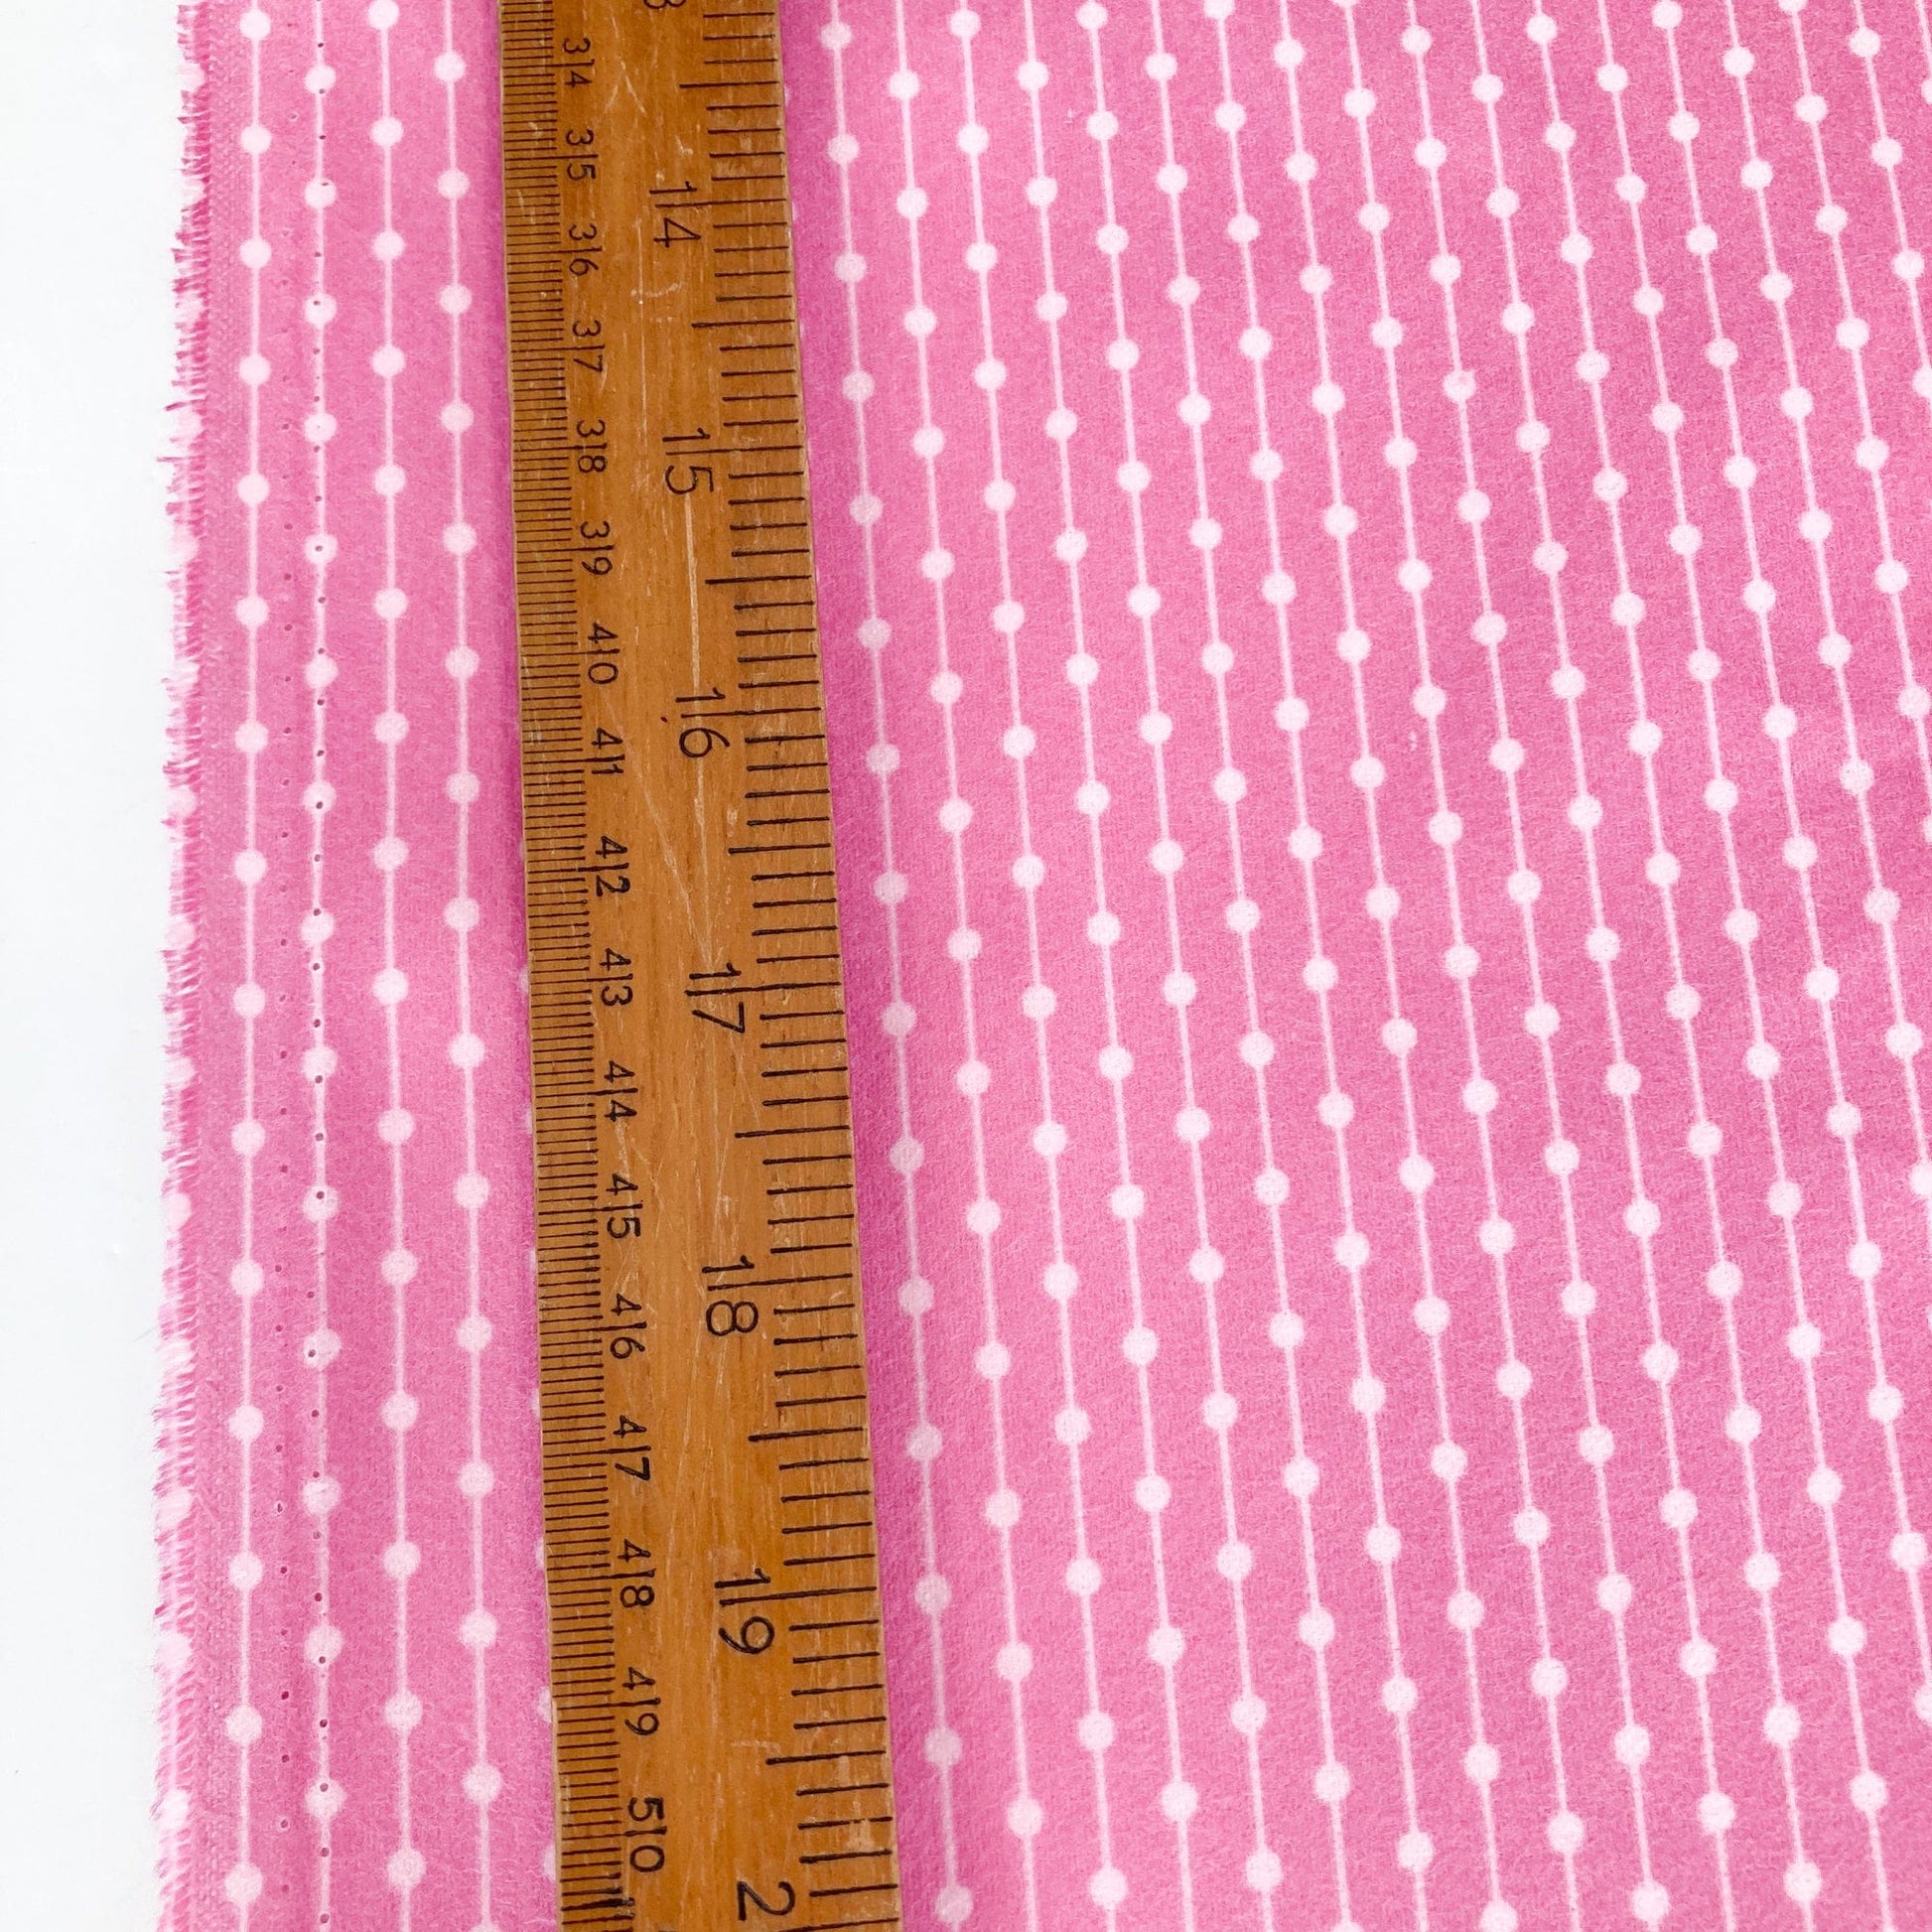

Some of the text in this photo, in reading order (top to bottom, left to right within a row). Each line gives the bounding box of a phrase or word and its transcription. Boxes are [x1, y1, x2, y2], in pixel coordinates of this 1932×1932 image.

[563, 37, 594, 88] 34
[566, 129, 596, 181] 35
[649, 181, 701, 247] 14
[569, 223, 599, 276] 36
[572, 320, 603, 373] 37
[576, 419, 608, 474] 38
[662, 427, 714, 494] 15
[580, 520, 613, 576] 39
[588, 621, 619, 684] 40
[591, 728, 623, 774] 41
[675, 687, 730, 758] 16
[596, 836, 630, 897] 42
[599, 948, 633, 1006] 43
[689, 962, 745, 1034] 17
[603, 1060, 637, 1122] 44
[606, 1173, 641, 1239] 45
[610, 1294, 645, 1359] 46
[701, 1255, 759, 1336] 18
[613, 1415, 650, 1480] 47
[618, 1539, 655, 1608] 48
[714, 1568, 774, 1655] 19
[621, 1667, 659, 1735] 49
[627, 1797, 665, 1872] 50
